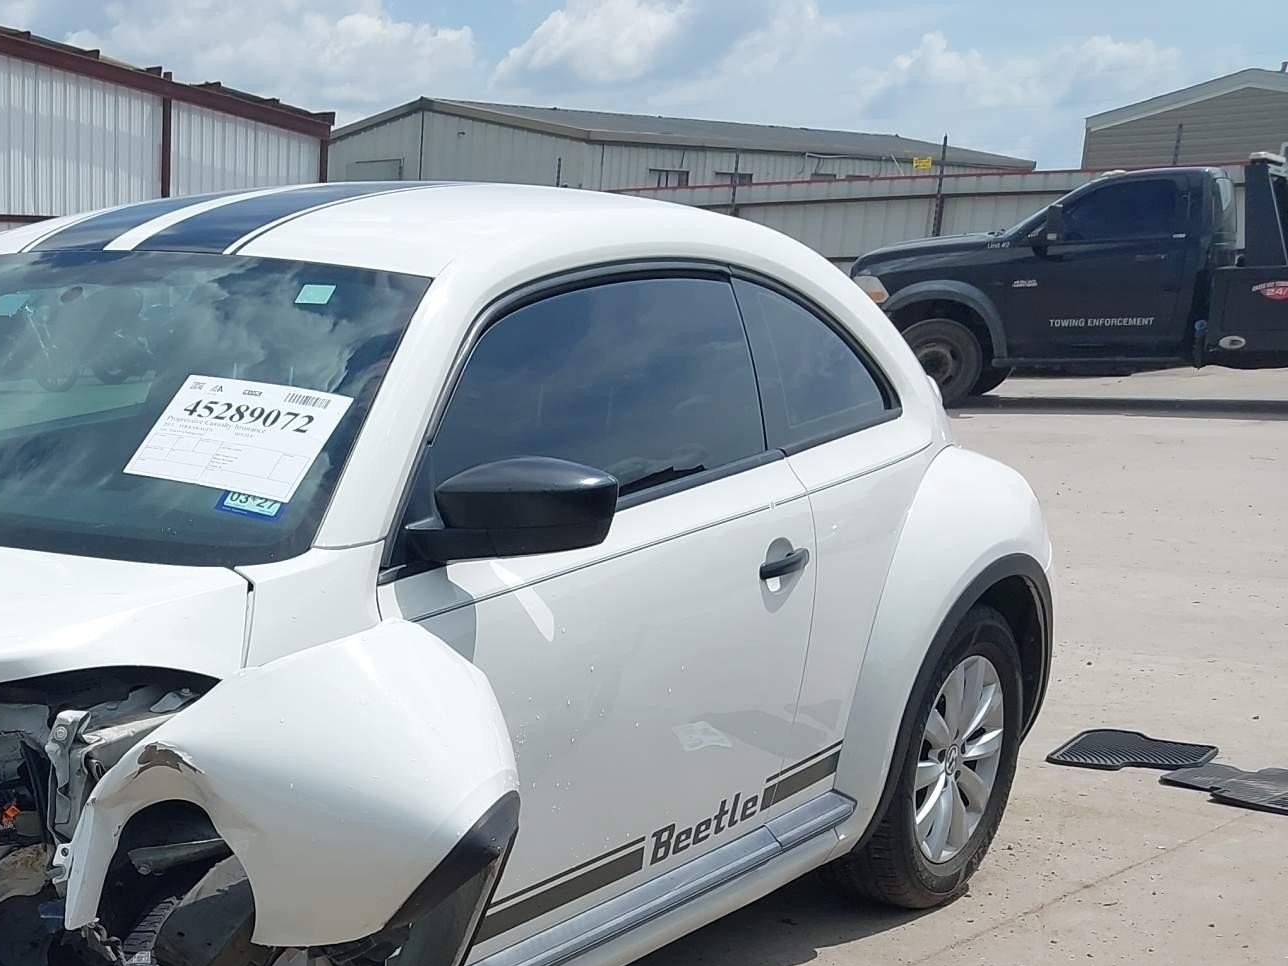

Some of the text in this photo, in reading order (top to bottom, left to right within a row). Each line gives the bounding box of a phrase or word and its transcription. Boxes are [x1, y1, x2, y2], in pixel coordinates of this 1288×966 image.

[1049, 317, 1155, 327] TOWING ENFORCEMENT
[183, 399, 315, 434] 45289072
[229, 491, 249, 503] 03
[256, 496, 278, 510] 27
[649, 792, 758, 866] Beetle
